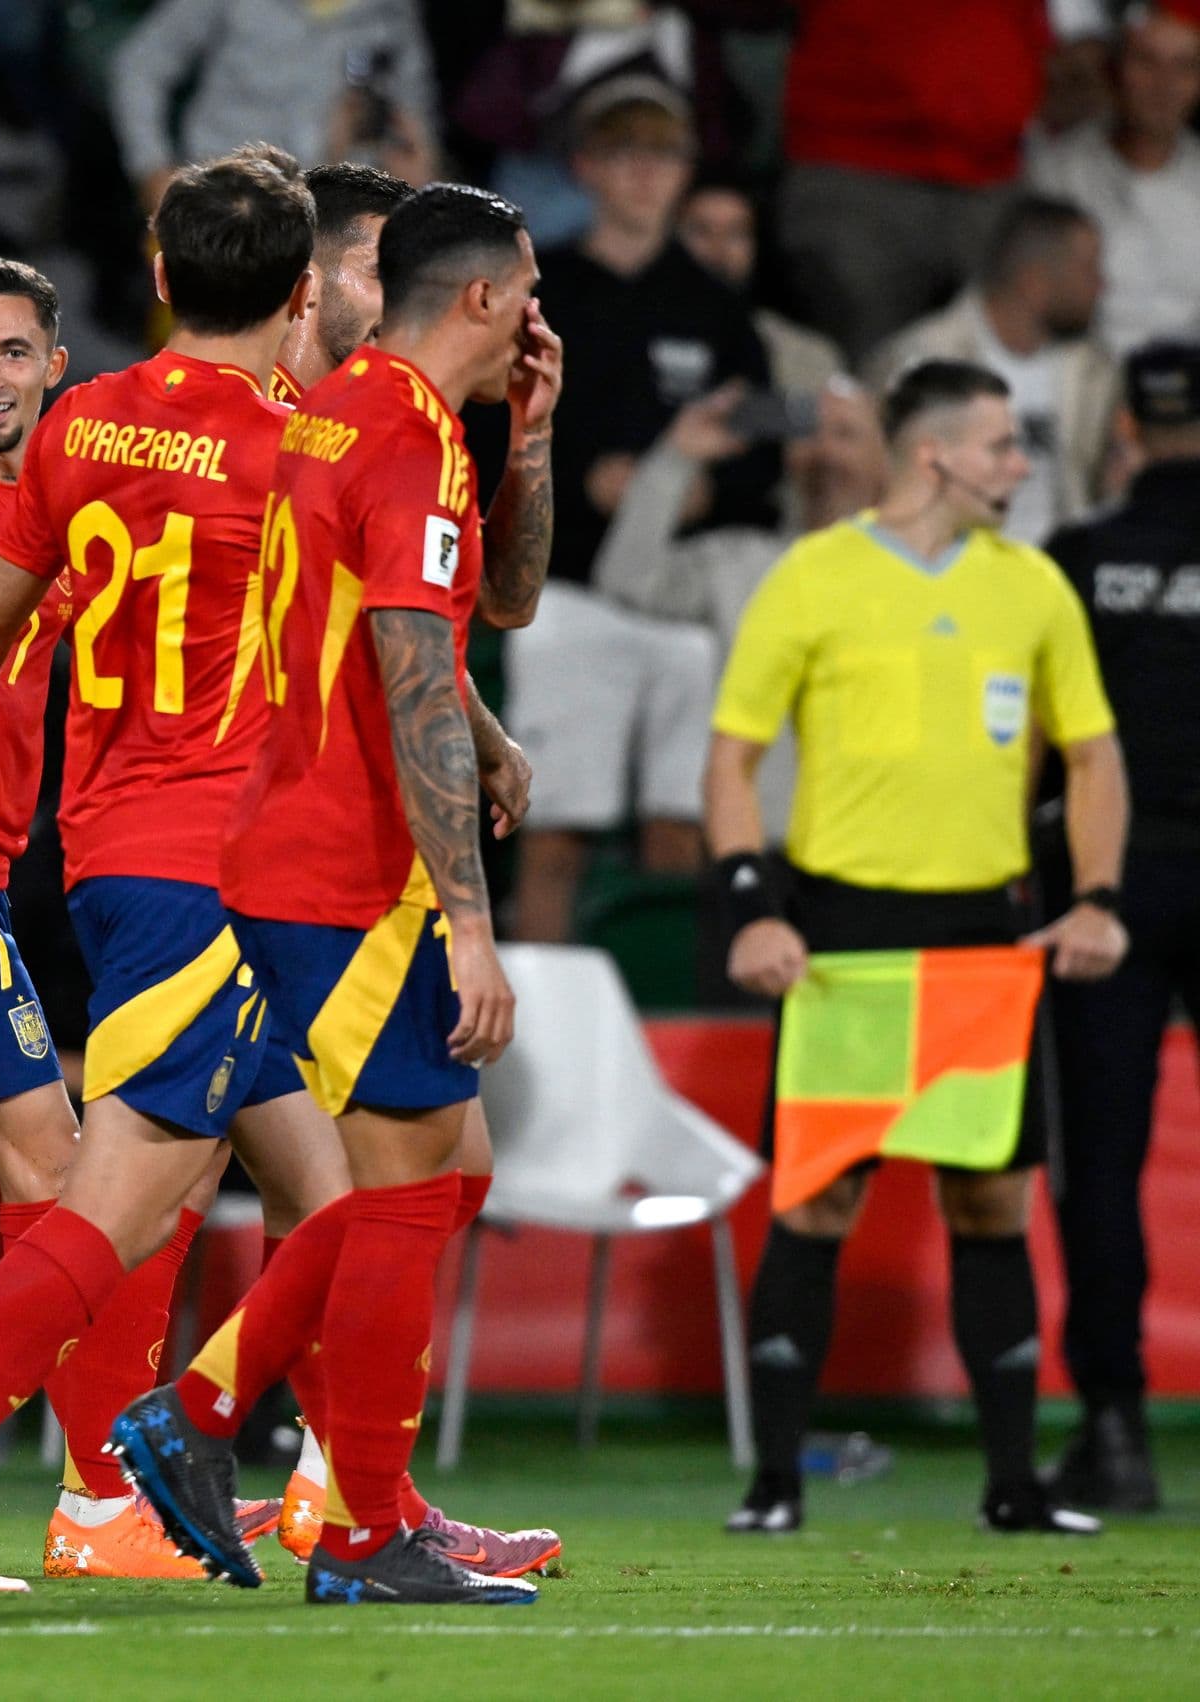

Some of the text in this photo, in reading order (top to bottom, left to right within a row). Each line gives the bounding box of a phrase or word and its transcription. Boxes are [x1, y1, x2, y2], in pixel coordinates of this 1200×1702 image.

[64, 416, 228, 482] OYARZABAL
[67, 500, 194, 715] 21
[432, 911, 458, 992] 1
